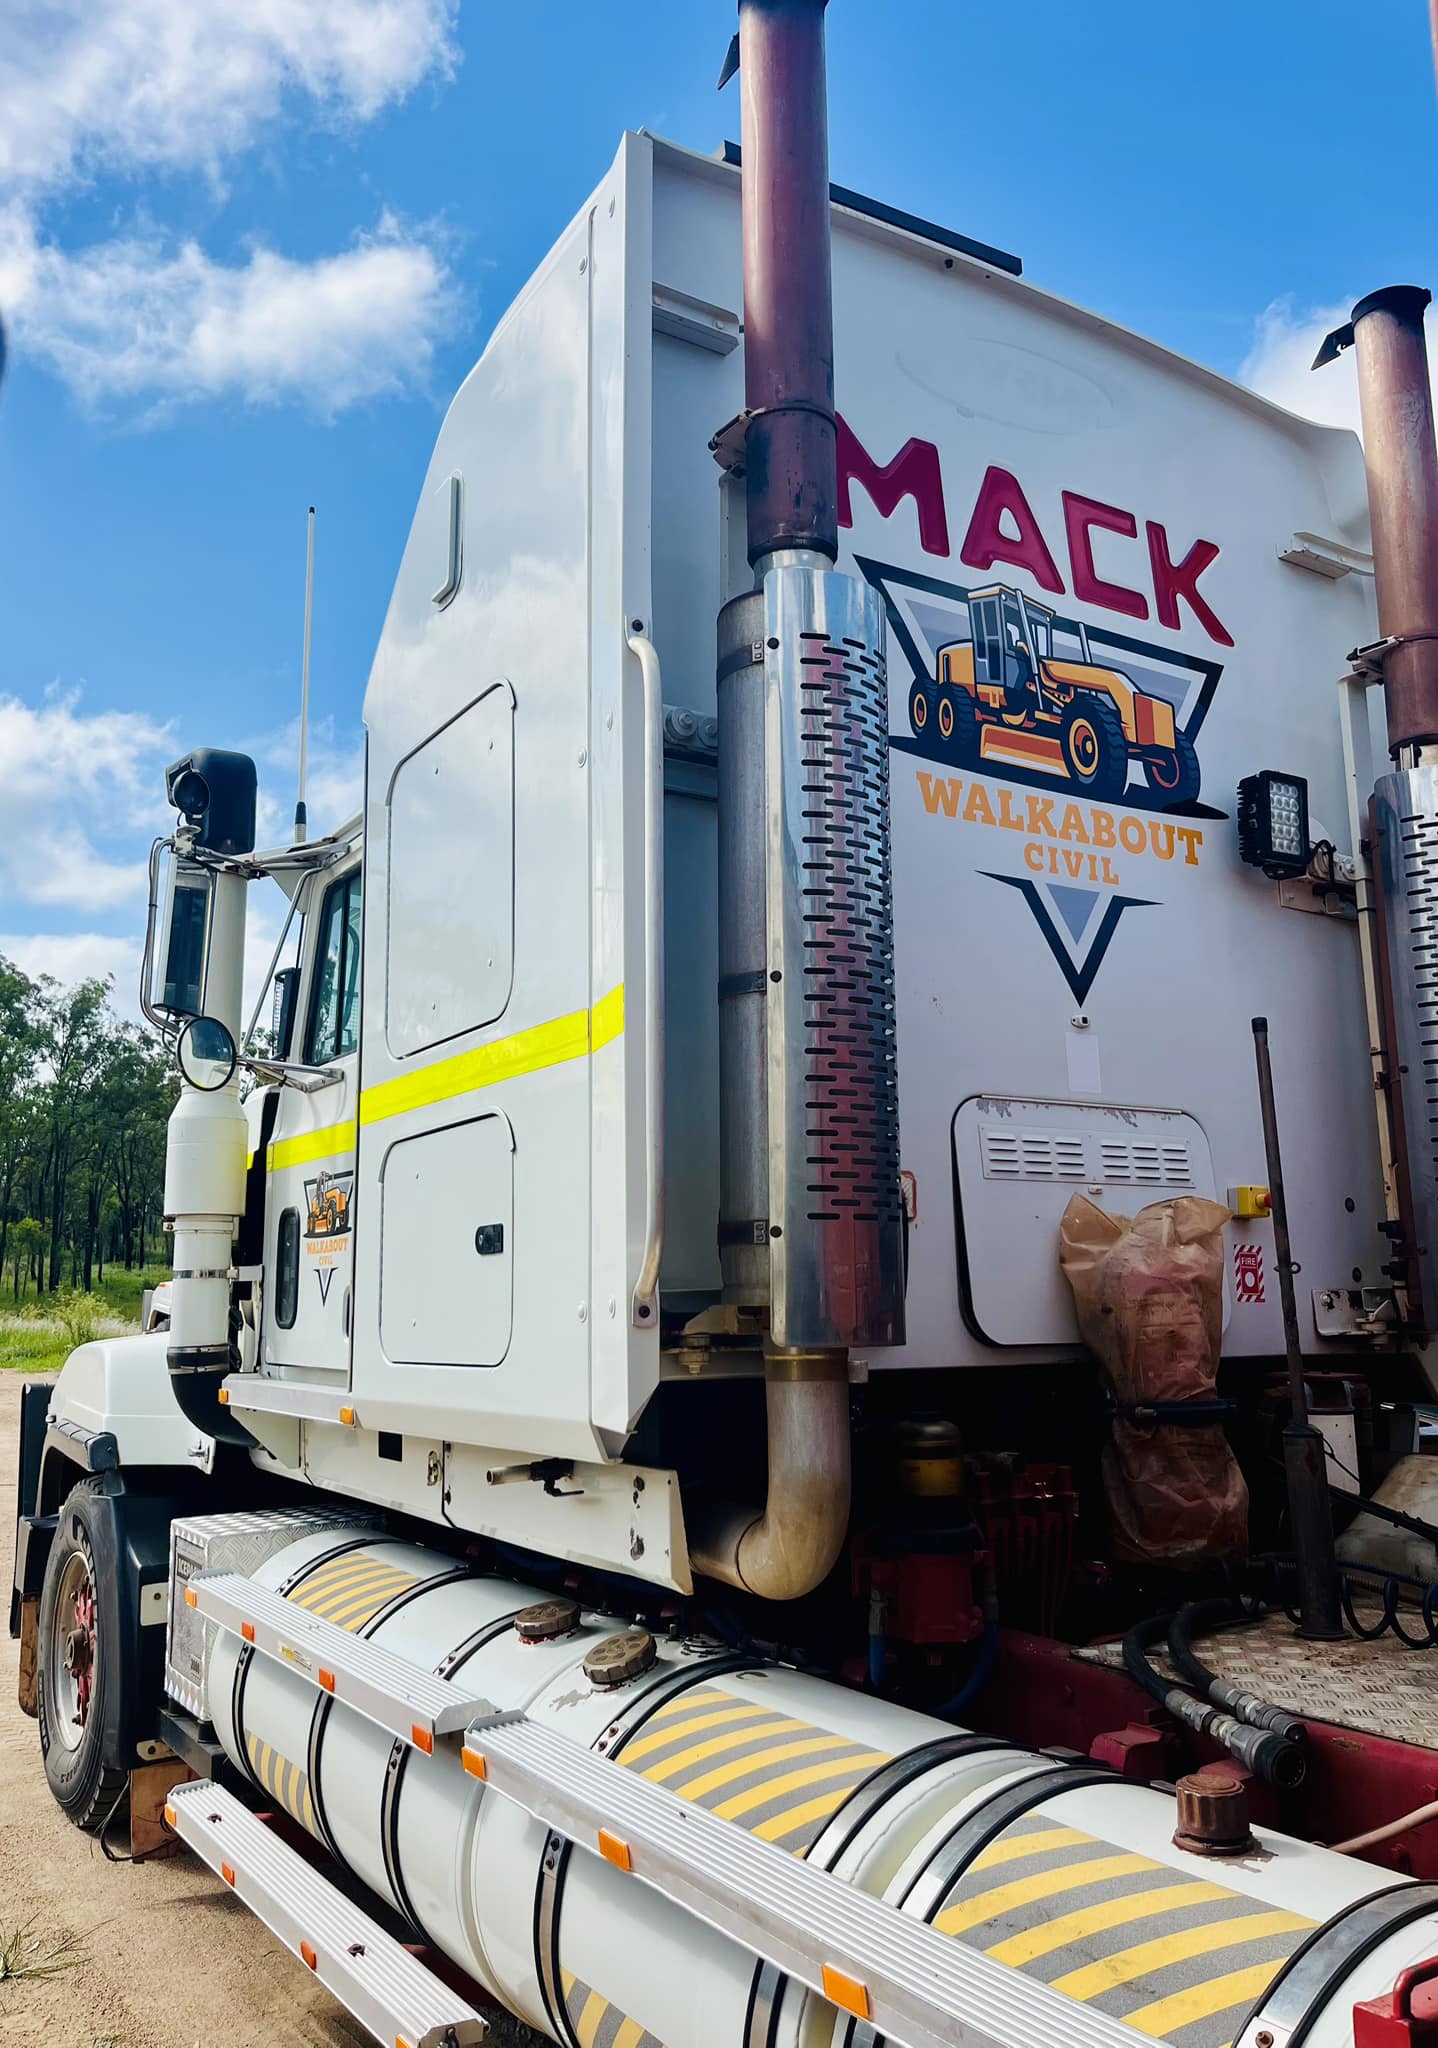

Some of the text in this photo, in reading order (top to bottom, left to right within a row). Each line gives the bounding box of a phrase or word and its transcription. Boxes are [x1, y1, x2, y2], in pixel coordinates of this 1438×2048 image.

[837, 411, 1235, 647] MACK
[916, 772, 1204, 867] WALKABOUT
[1023, 842, 1120, 885] CIVIL
[306, 1237, 349, 1256] WALKABOUT
[1241, 1256, 1257, 1266] FIRE
